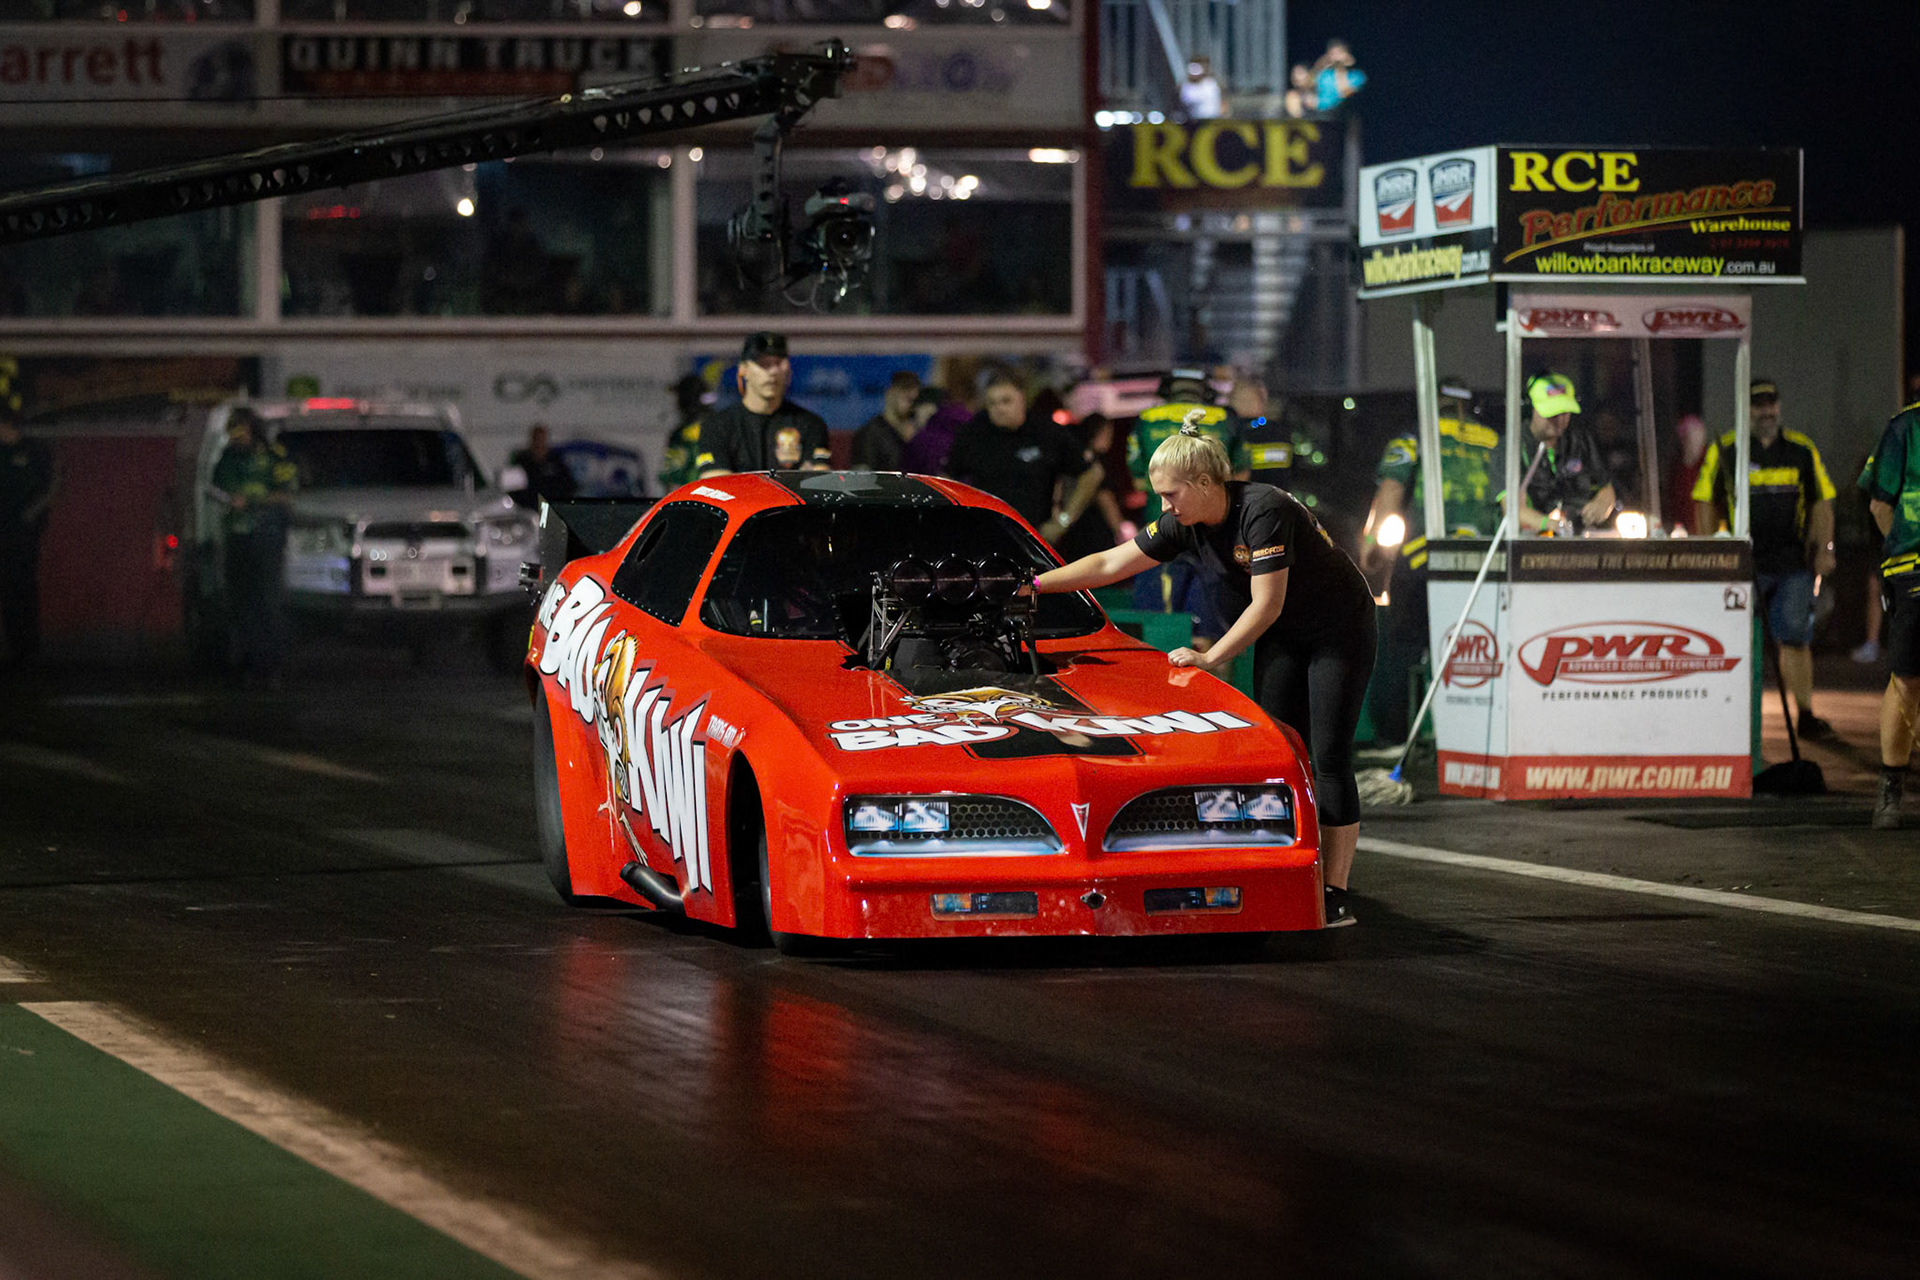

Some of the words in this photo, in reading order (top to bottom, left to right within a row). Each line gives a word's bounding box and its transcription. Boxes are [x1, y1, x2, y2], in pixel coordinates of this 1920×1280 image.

[1130, 119, 1325, 188] RCE
[1509, 151, 1640, 192] RCE
[1519, 179, 1776, 246] Performance
[1691, 217, 1791, 234] Warehouse
[1536, 252, 1776, 276] willowbankraceway.com.au
[1536, 635, 1697, 685] PWR
[1567, 660, 1619, 671] ADVANCED
[1620, 660, 1662, 671] COOLING
[1664, 660, 1725, 671] TECHNOLOGY
[1542, 689, 1636, 700] PERFORMANCE
[1640, 688, 1708, 699] PRODUCTS
[539, 574, 614, 724] BAD
[624, 668, 713, 893] KIWI
[830, 713, 936, 731] ONE
[830, 723, 1012, 752] BAD
[1016, 710, 1255, 737] KIWI
[1526, 766, 1733, 792] www.pwr.com.au
